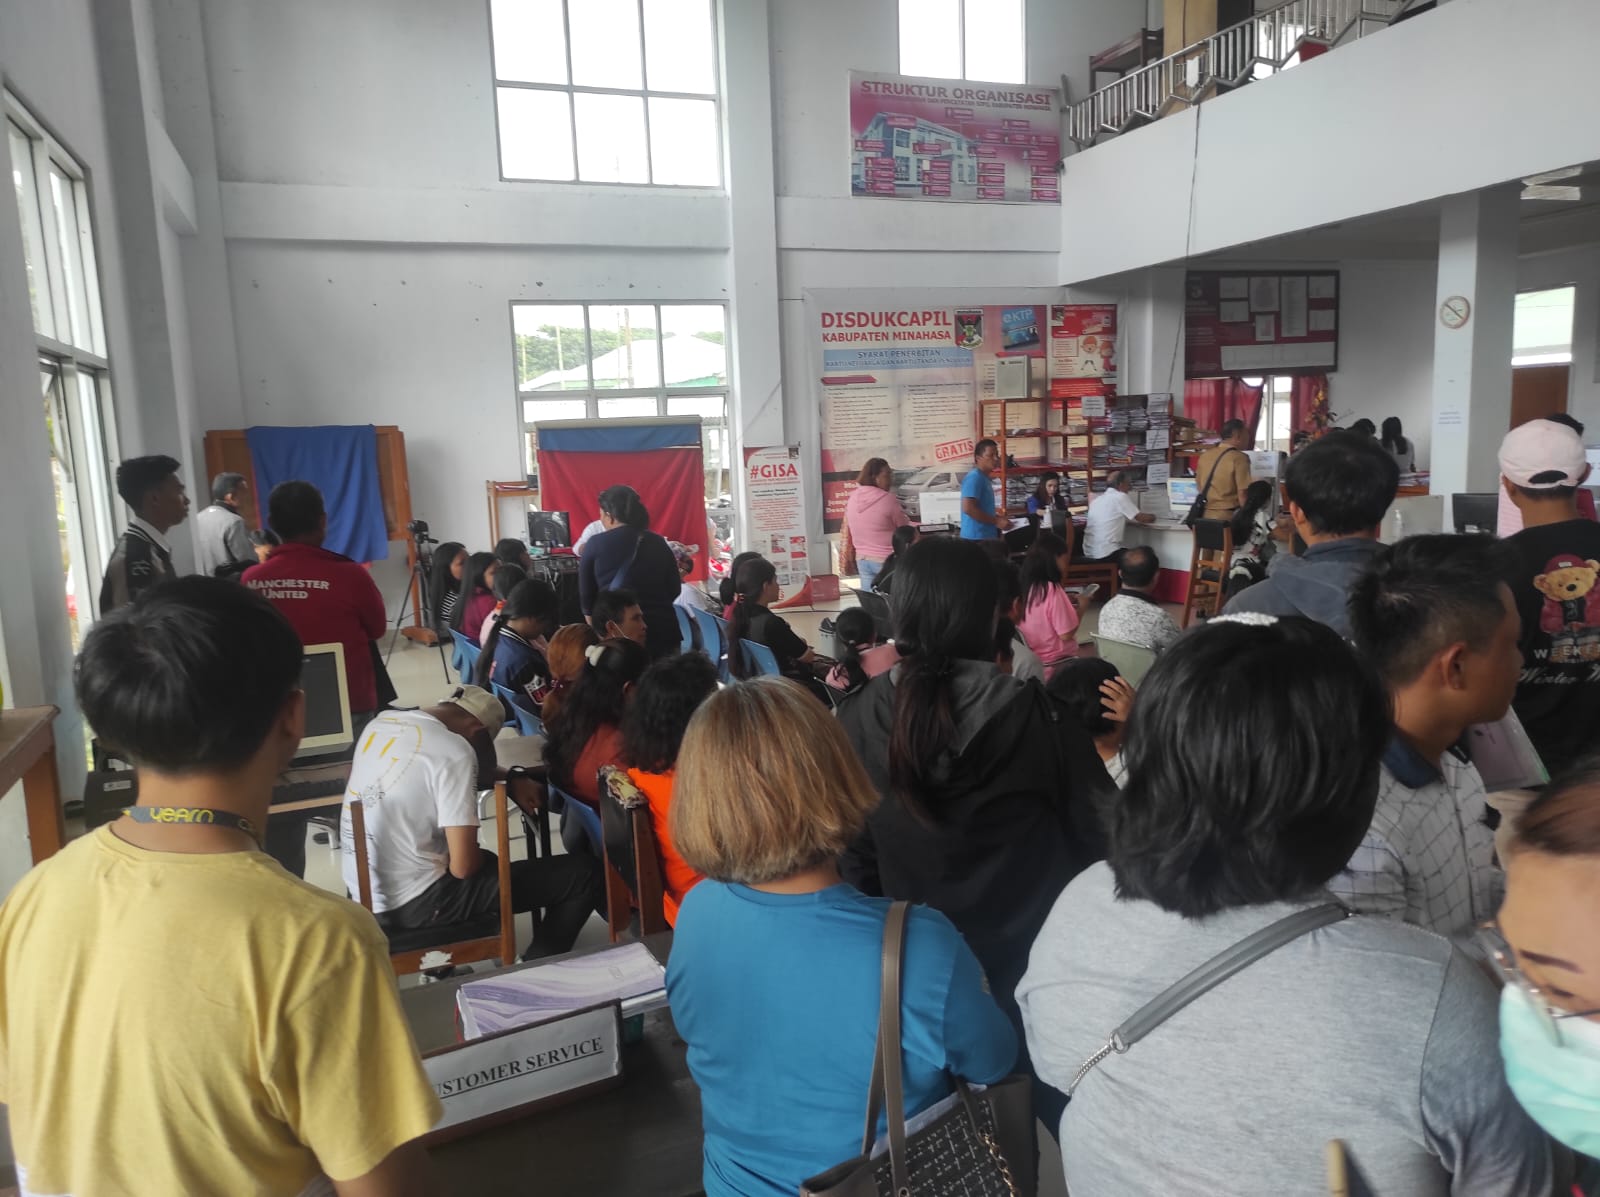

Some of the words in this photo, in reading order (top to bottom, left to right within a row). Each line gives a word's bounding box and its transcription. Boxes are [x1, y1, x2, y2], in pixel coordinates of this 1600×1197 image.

[861, 80, 948, 98] STRUKTUR
[952, 87, 1051, 105] ORGANISASI
[821, 311, 952, 328] DISDUKCAPIL
[822, 331, 889, 342] KABUPATEN
[893, 330, 952, 341] MINAHASA
[858, 351, 888, 359] SYARAT
[890, 349, 941, 358] PENERBITAN
[936, 440, 974, 459] GRATIS
[750, 463, 798, 479] #GISA
[247, 579, 329, 590] MANCHESTER
[263, 588, 308, 599] UNITED
[433, 1060, 521, 1096] USTOMER
[526, 1037, 603, 1070] SERVICE
